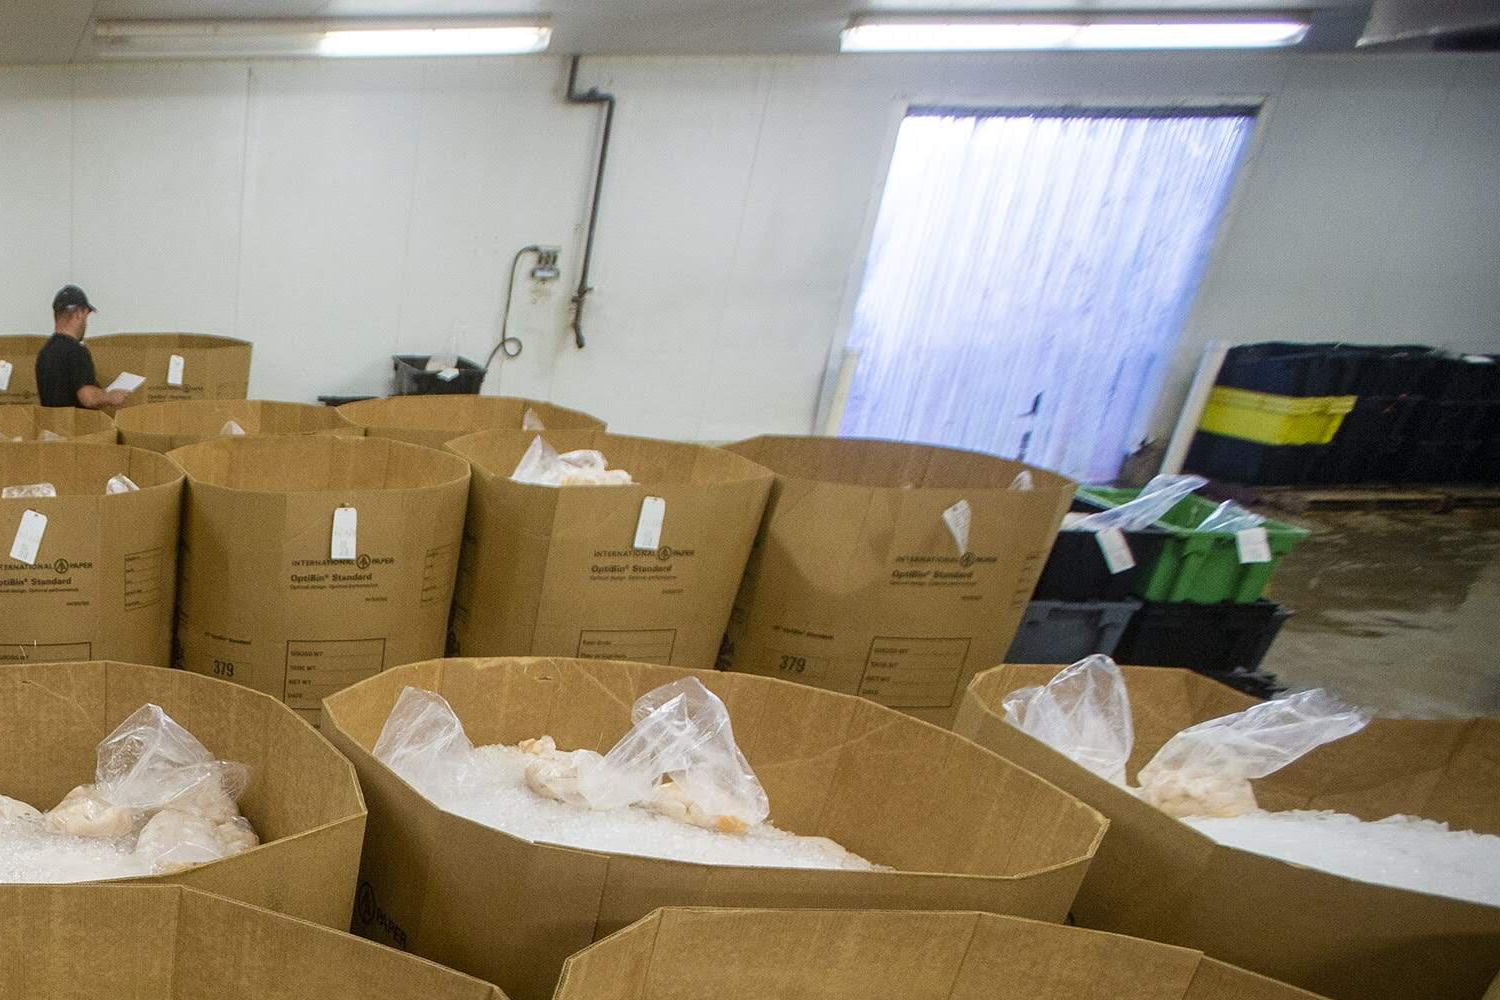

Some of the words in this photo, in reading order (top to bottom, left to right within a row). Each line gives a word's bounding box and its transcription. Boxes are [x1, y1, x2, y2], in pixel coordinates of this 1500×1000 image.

[30, 576, 72, 586] Standard
[332, 572, 373, 581] Standard
[213, 659, 235, 678] 379
[779, 654, 806, 673] 379
